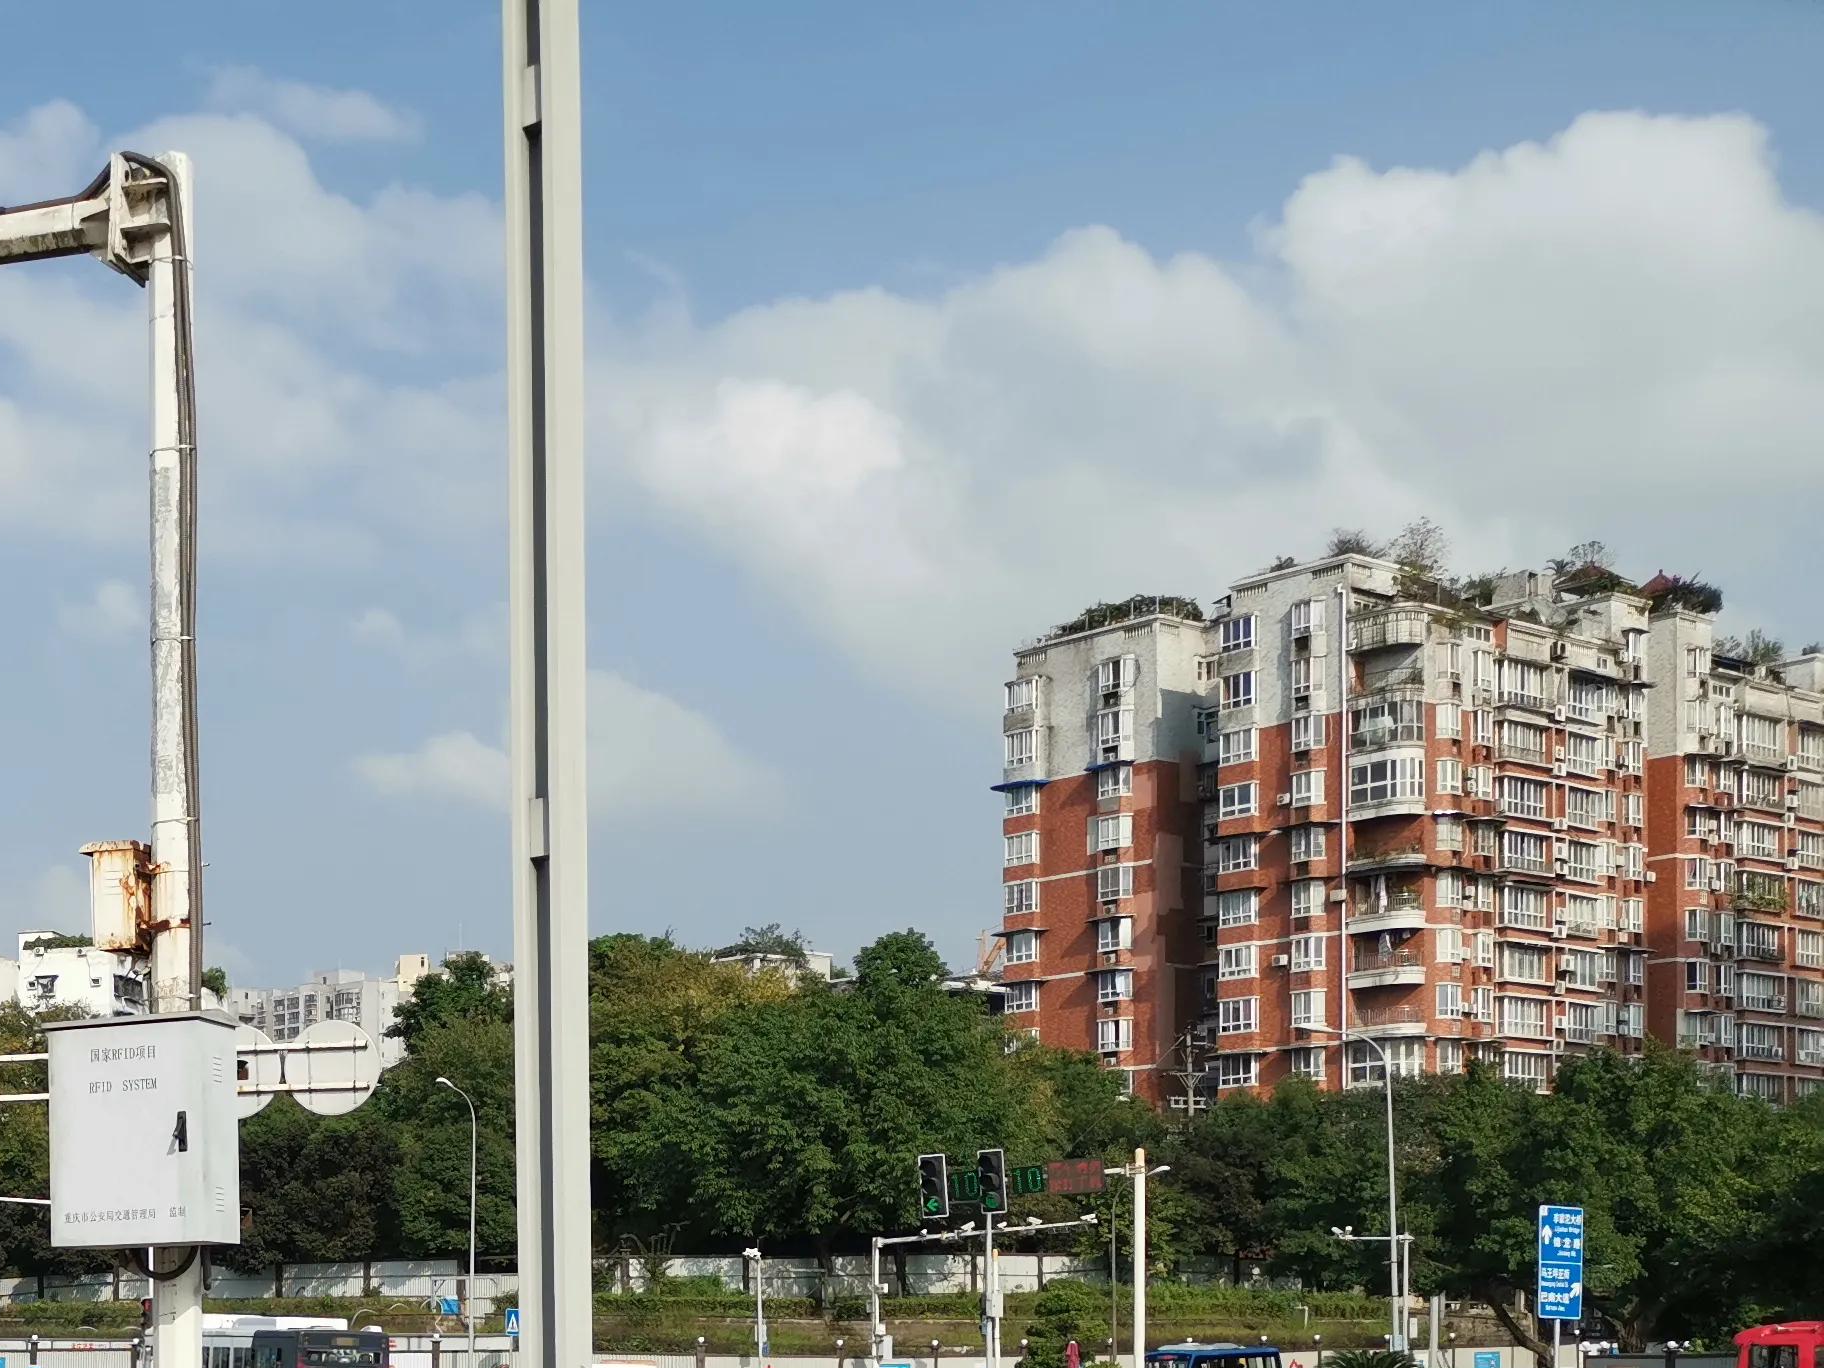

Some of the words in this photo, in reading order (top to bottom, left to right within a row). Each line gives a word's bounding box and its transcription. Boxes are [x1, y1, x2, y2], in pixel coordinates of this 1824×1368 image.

[90, 1045, 156, 1063] 国家RFID项目
[89, 1081, 112, 1094] RFID
[122, 1078, 157, 1092] SYSTEM
[1014, 1168, 1042, 1194] 10
[64, 1209, 156, 1224] 重庆市公安局交通管理局
